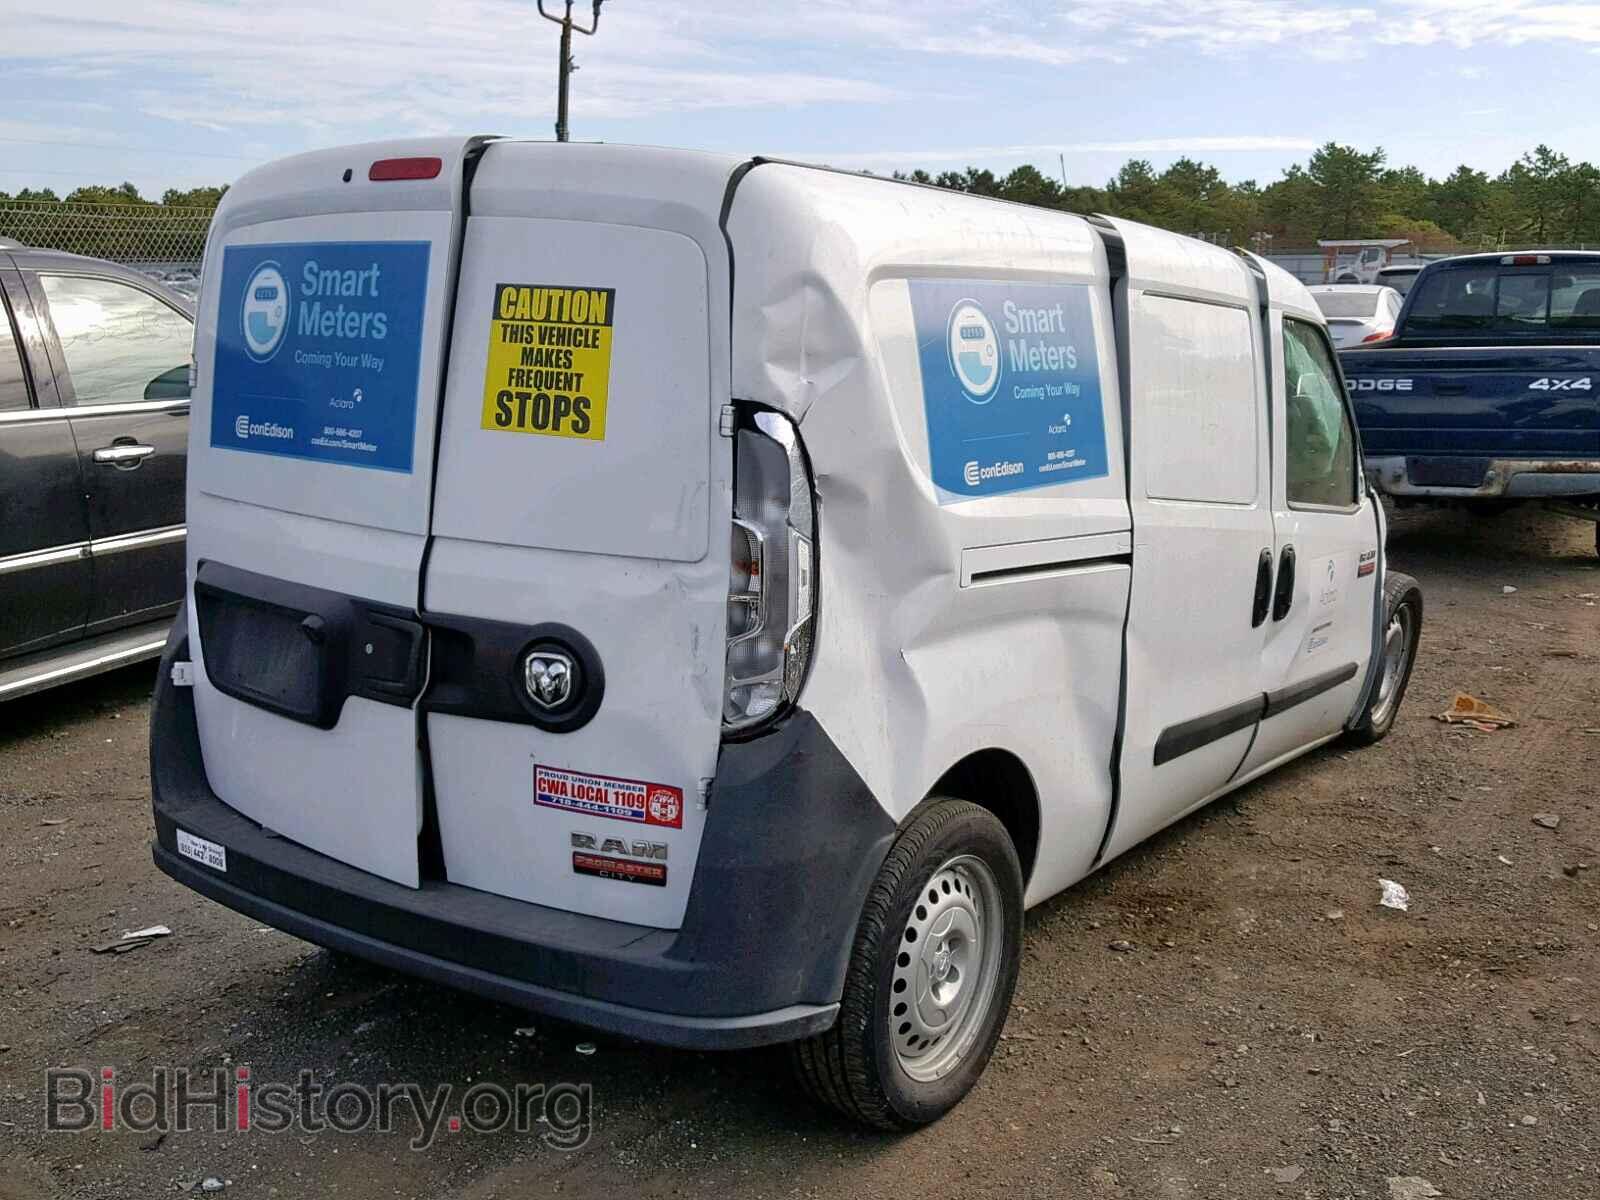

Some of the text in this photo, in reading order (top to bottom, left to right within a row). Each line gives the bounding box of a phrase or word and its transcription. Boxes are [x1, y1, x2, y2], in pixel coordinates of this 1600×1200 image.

[301, 260, 380, 297] Smart
[500, 286, 608, 324] CAUTION
[1003, 300, 1066, 334] Smart
[297, 301, 388, 340] Meters
[501, 324, 601, 350] THIS VEHICLE
[295, 350, 385, 373] Coming Your Way
[520, 346, 573, 370] MAKES
[1009, 339, 1078, 373] Meters
[507, 367, 585, 393] FREQUENT
[1013, 382, 1081, 400] Coming Your Way
[495, 390, 592, 435] STOPS
[249, 422, 294, 439] conEdison
[980, 461, 1024, 479] conEdison
[537, 776, 645, 810] CWA LOCAL 1109
[538, 769, 645, 793] PROUD UNION MEMBER
[570, 832, 668, 861] RAM
[599, 870, 636, 882] CITY
